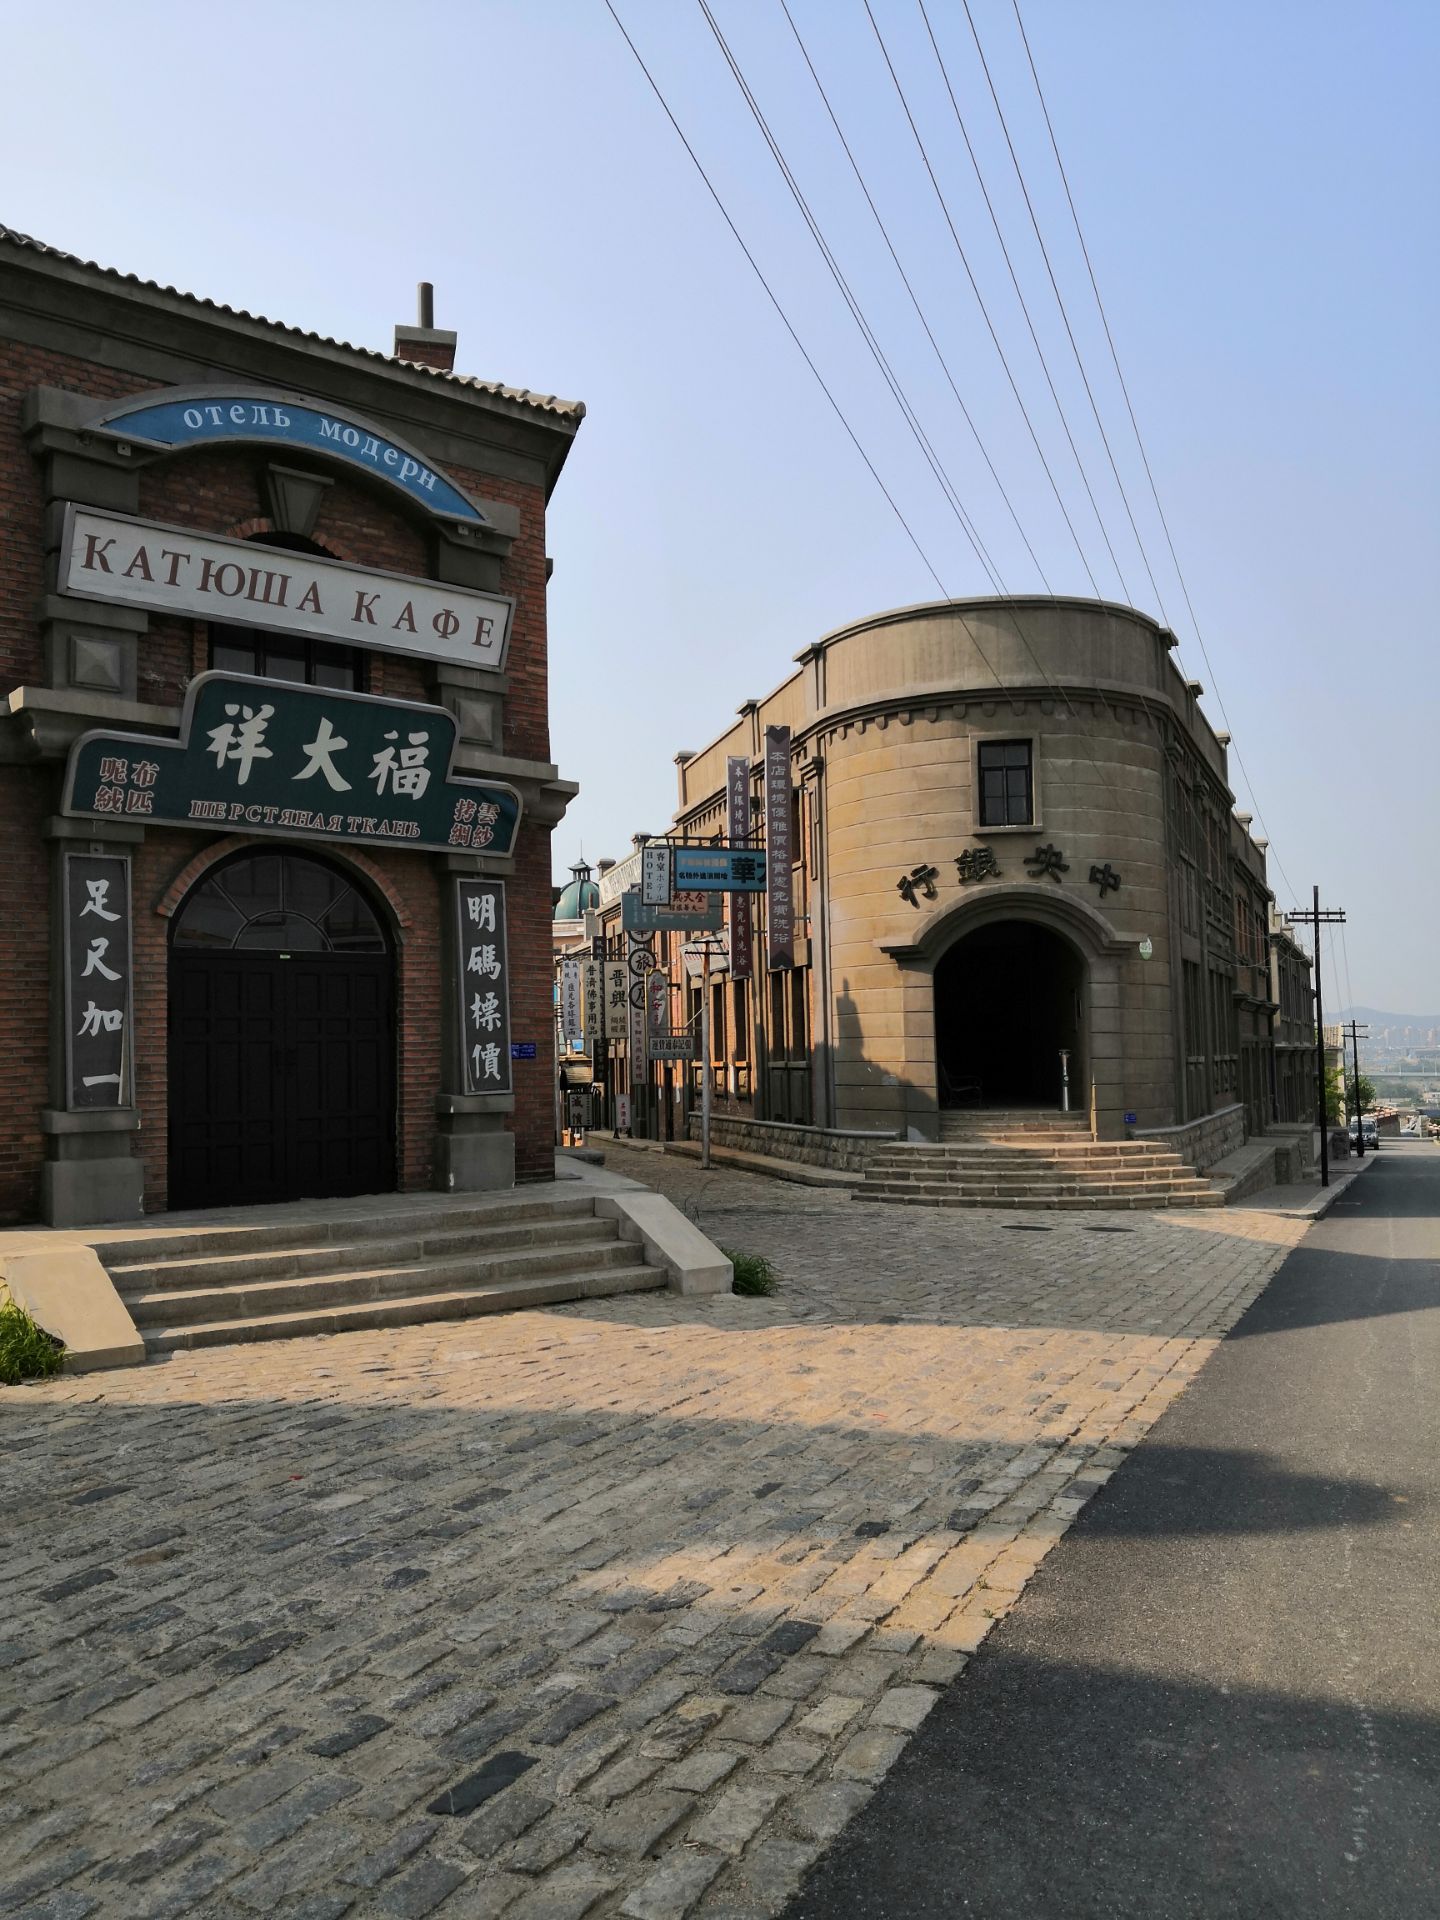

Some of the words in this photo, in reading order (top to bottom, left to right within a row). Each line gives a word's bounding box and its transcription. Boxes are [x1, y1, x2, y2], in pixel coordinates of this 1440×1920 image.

[183, 401, 291, 429] отель
[318, 416, 440, 494] модерн
[81, 533, 326, 616] КАТЮША
[350, 589, 496, 650] КАФЕ
[346, 815, 422, 839] ТКАНЬ
[646, 851, 654, 900] HOTEL
[77, 879, 124, 1089] 足尺加一
[466, 893, 502, 1083] 明碼標價
